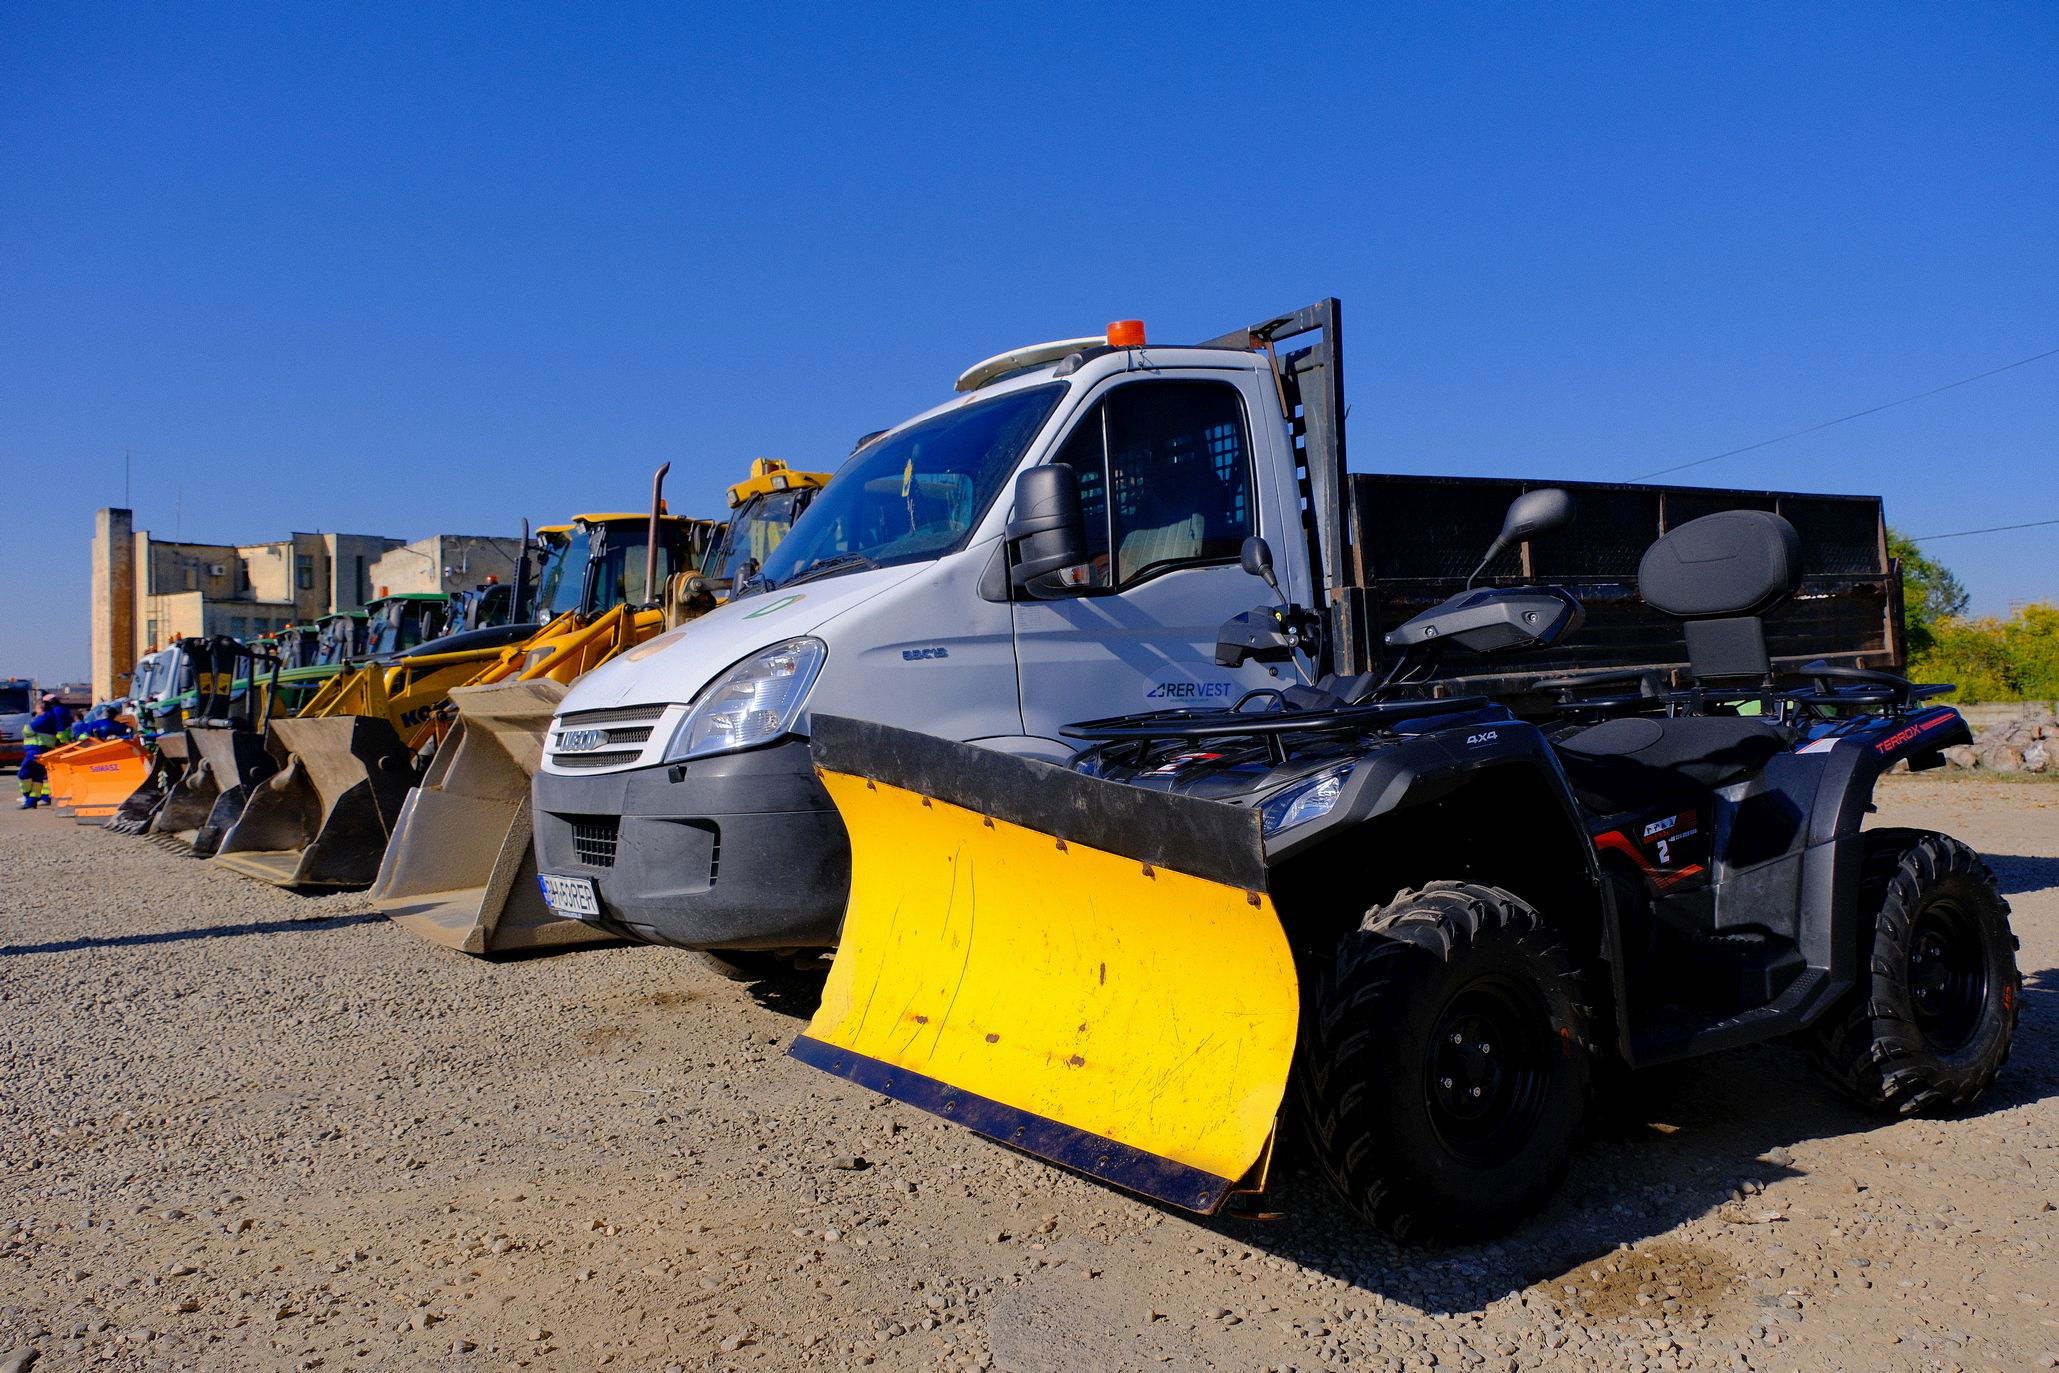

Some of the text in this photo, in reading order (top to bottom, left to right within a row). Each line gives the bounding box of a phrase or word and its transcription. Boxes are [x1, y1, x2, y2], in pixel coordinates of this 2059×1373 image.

[1166, 683, 1231, 697] RER VEST
[560, 730, 598, 751] IVECO
[1876, 724, 1921, 754] TERROX
[1657, 840, 1670, 864] 2
